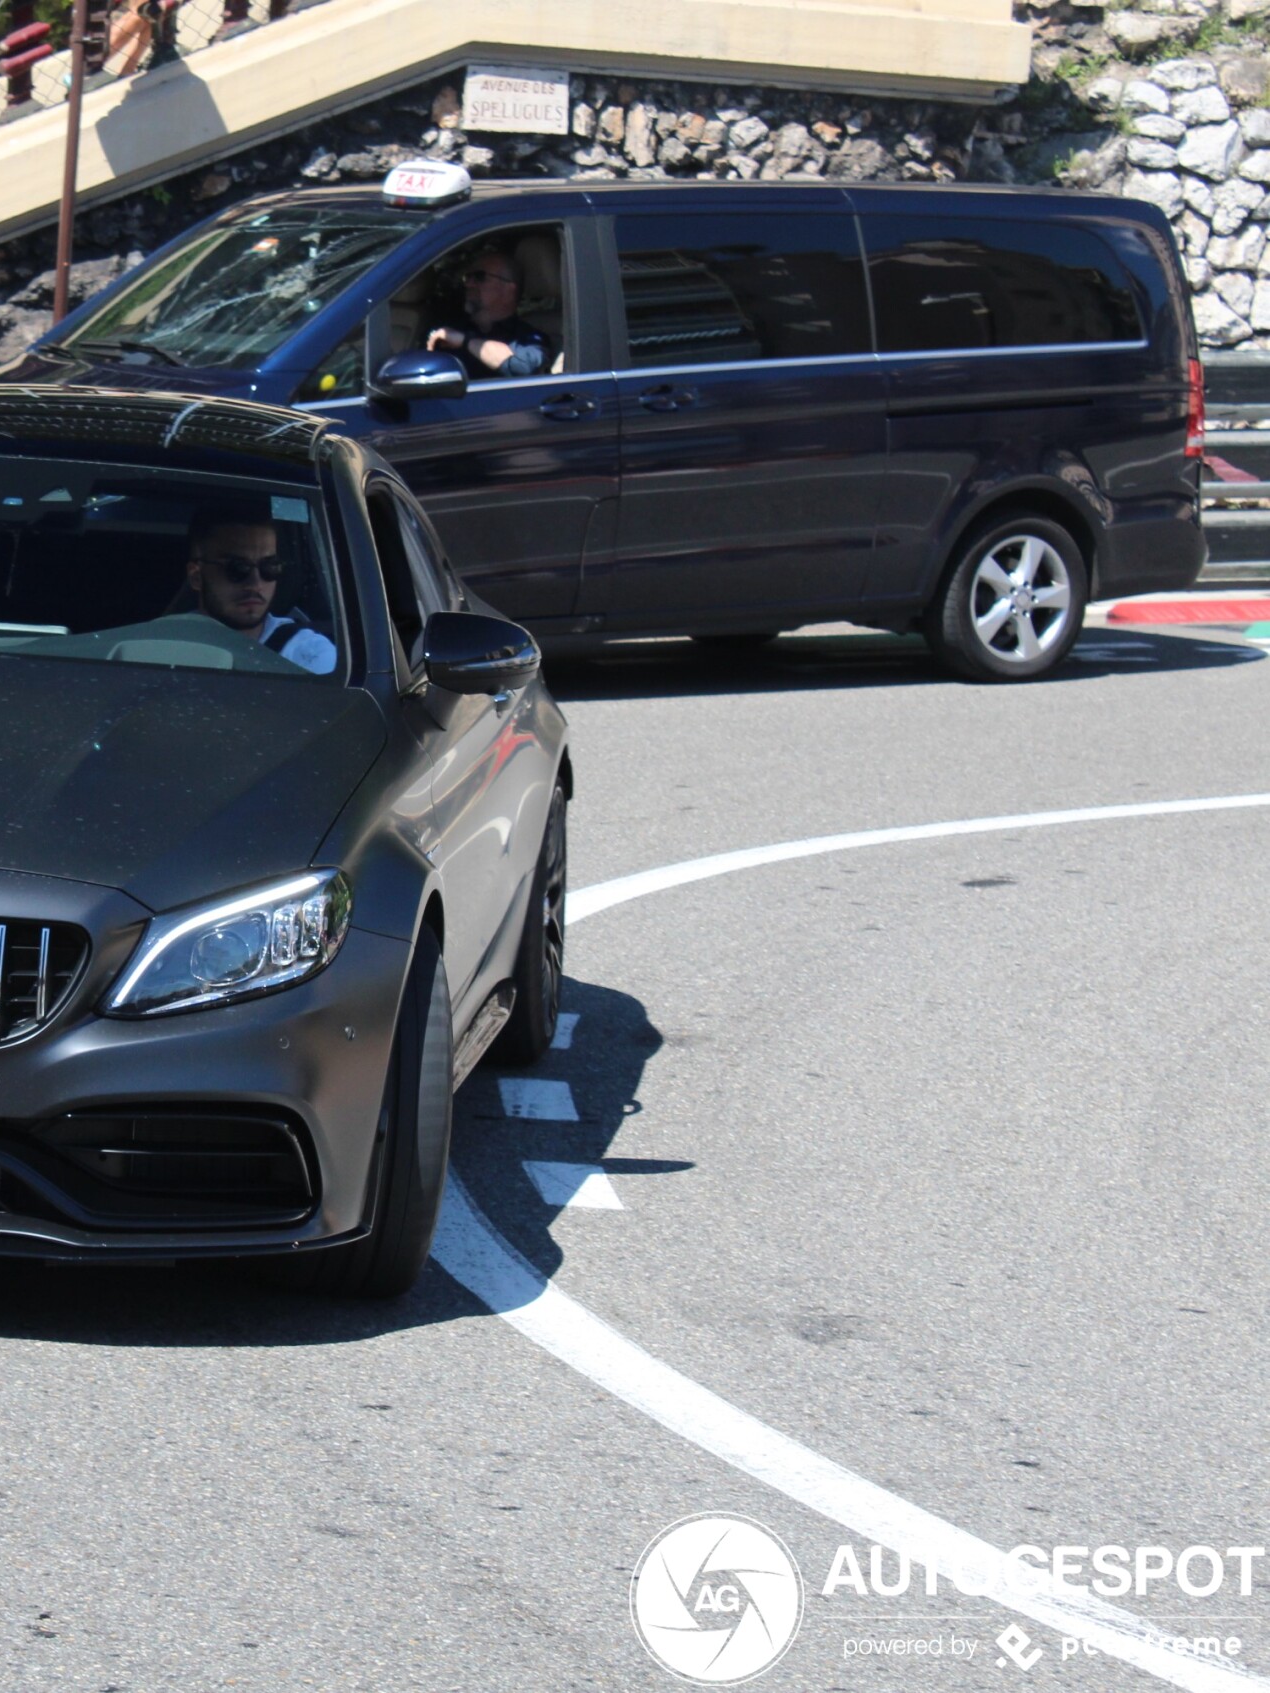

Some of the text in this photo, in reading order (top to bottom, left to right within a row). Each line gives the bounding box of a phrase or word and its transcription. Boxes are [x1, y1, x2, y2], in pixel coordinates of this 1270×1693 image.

[481, 80, 555, 95] AVENUE DES
[471, 101, 564, 121] SPELUGUES
[396, 173, 434, 189] TAXI
